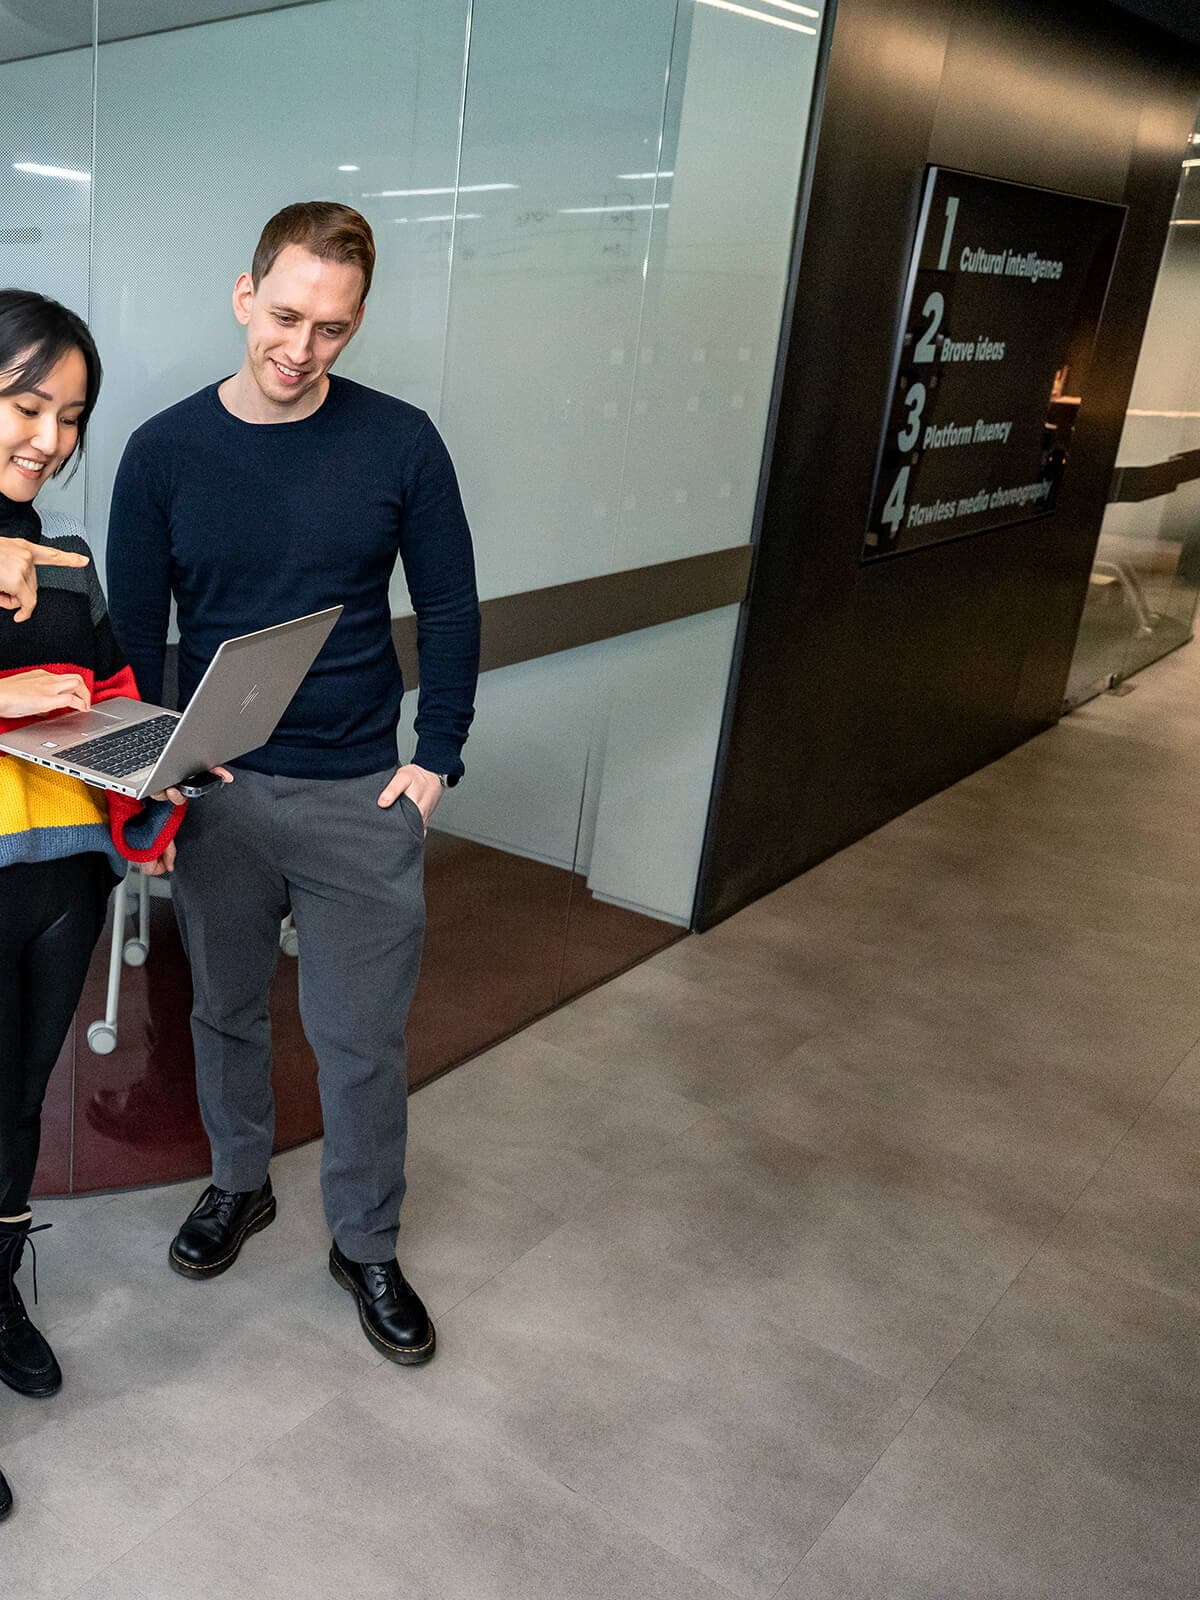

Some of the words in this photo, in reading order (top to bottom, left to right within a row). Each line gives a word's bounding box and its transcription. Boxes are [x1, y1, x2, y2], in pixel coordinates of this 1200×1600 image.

[938, 197, 960, 270] 1
[960, 246, 1006, 275] Cultural
[1004, 249, 1064, 283] intelligence
[913, 291, 945, 363] 2
[941, 338, 975, 362] Brave
[975, 335, 1006, 361] ideas
[898, 382, 926, 452] 3
[922, 421, 973, 450] Platform
[972, 419, 1013, 444] fluency
[881, 466, 911, 532] 4
[906, 500, 957, 529] Flawless
[956, 488, 991, 517] media
